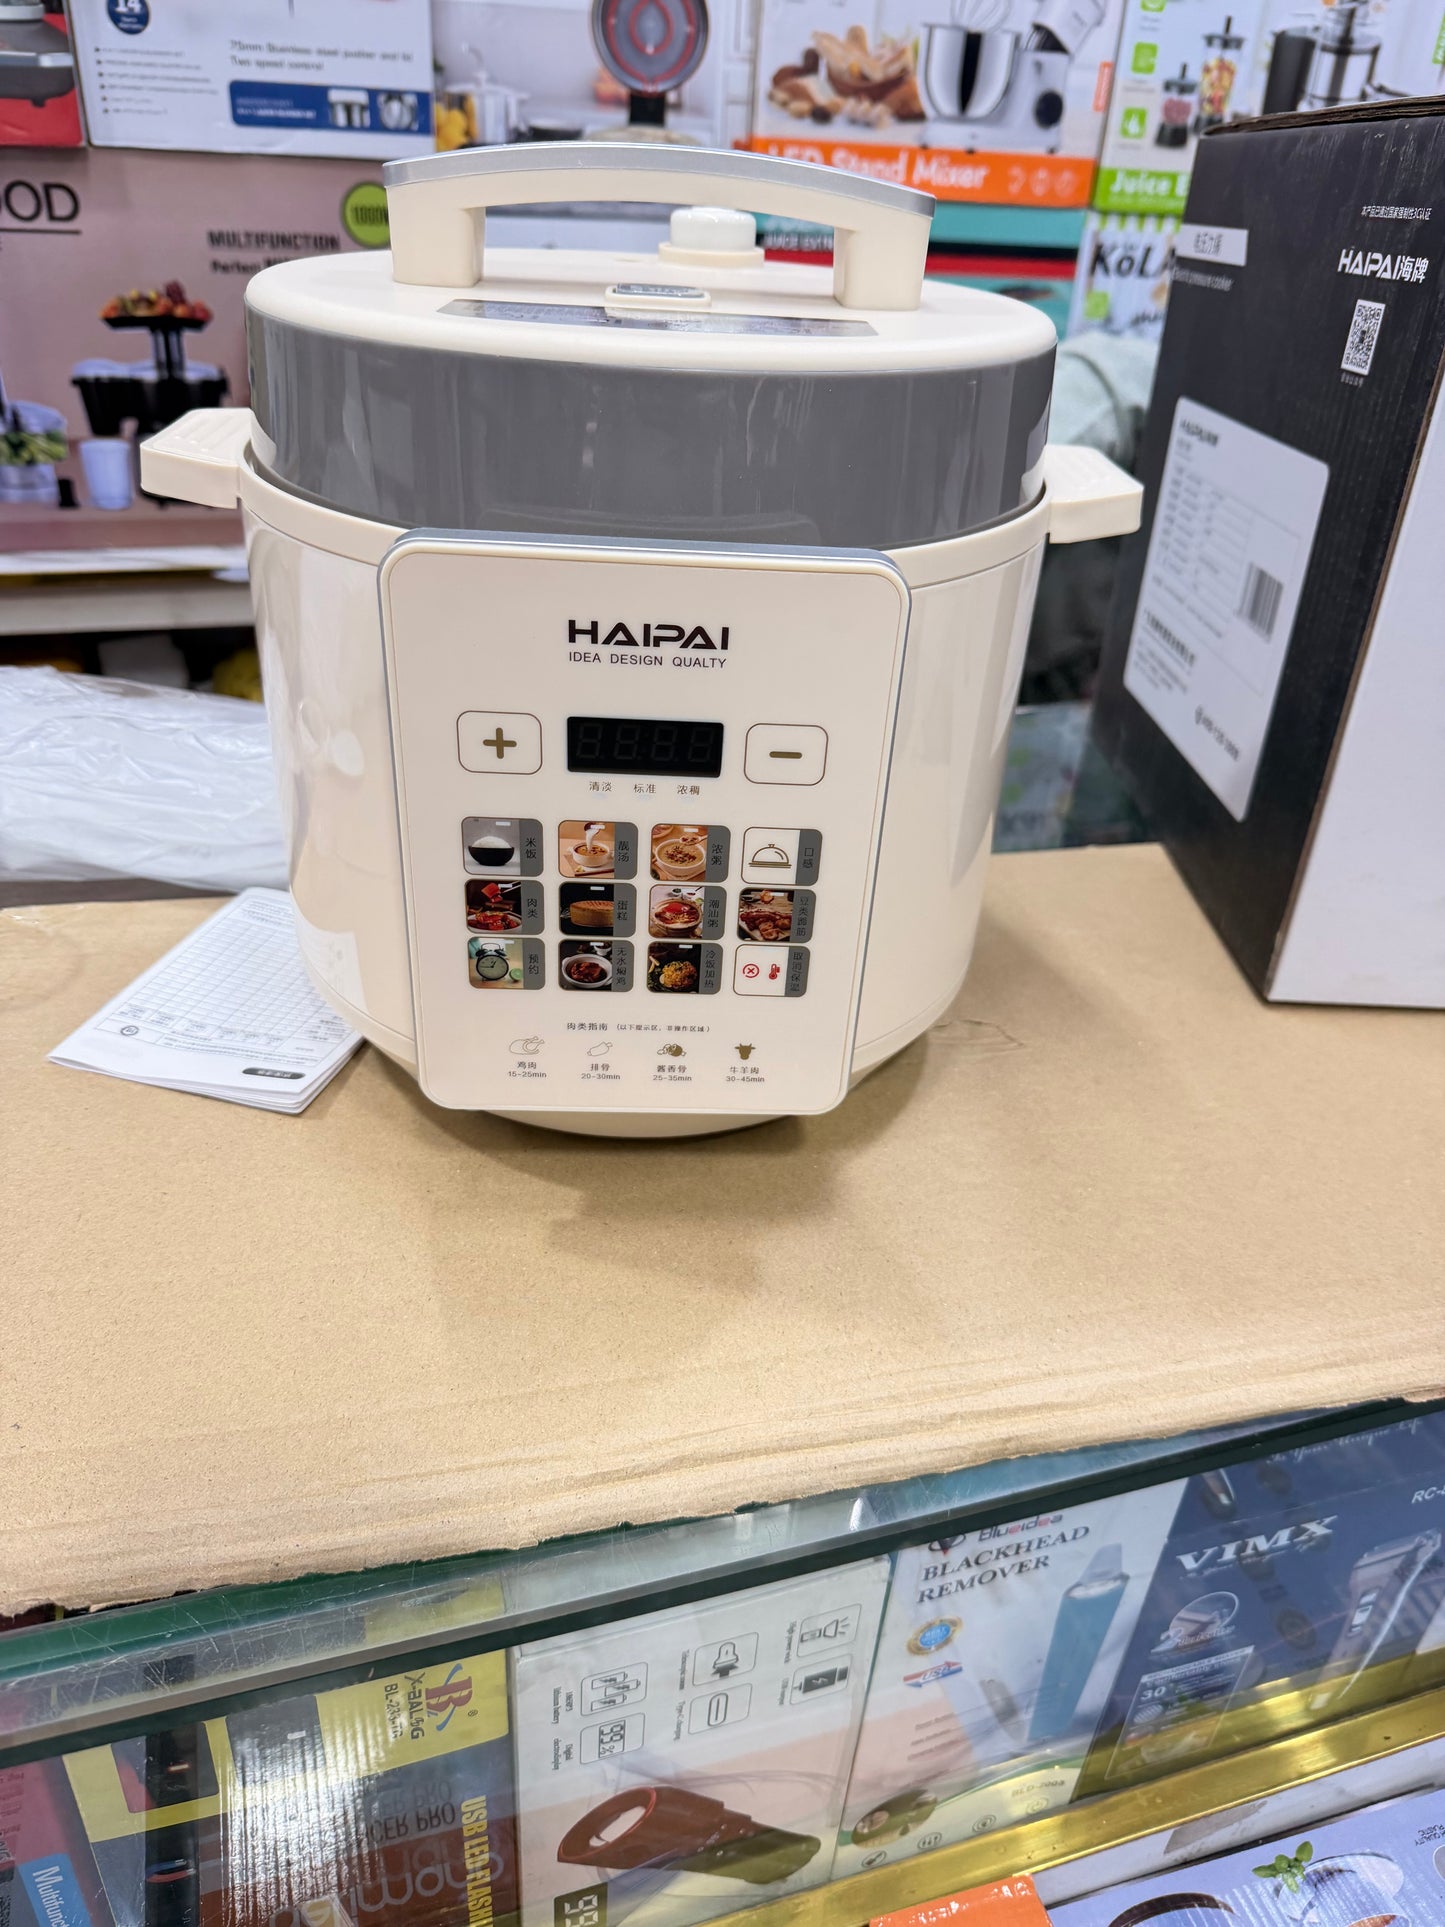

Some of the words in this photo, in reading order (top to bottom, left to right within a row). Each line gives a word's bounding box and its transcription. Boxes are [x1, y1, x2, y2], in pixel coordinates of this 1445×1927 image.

[912, 153, 989, 190] Mixer
[1110, 171, 1172, 197] Juice
[208, 230, 341, 251] MULTIFUNCTION
[568, 619, 730, 650] HAIPAI
[569, 651, 601, 664] IDEA
[610, 653, 663, 666] DESIGN
[672, 656, 727, 669] QUALTY
[588, 780, 613, 793] 清淡
[633, 783, 657, 794] 标准
[525, 837, 537, 860] 米饭
[567, 1022, 608, 1033] 肉类指南
[507, 1070, 547, 1079] 15-25min
[516, 1061, 537, 1070] 鸡肉
[580, 1072, 621, 1081] 20-30min
[652, 1074, 692, 1082] 25-35min
[725, 1075, 765, 1083] 30-45min
[1176, 1514, 1338, 1571] VIMX
[922, 1525, 1090, 1582] BLACKHEAD
[916, 1555, 1050, 1604] REMOVER
[460, 1794, 488, 1836] USB
[1414, 1832, 1441, 1847] QUALITY
[463, 1835, 490, 1868] LED
